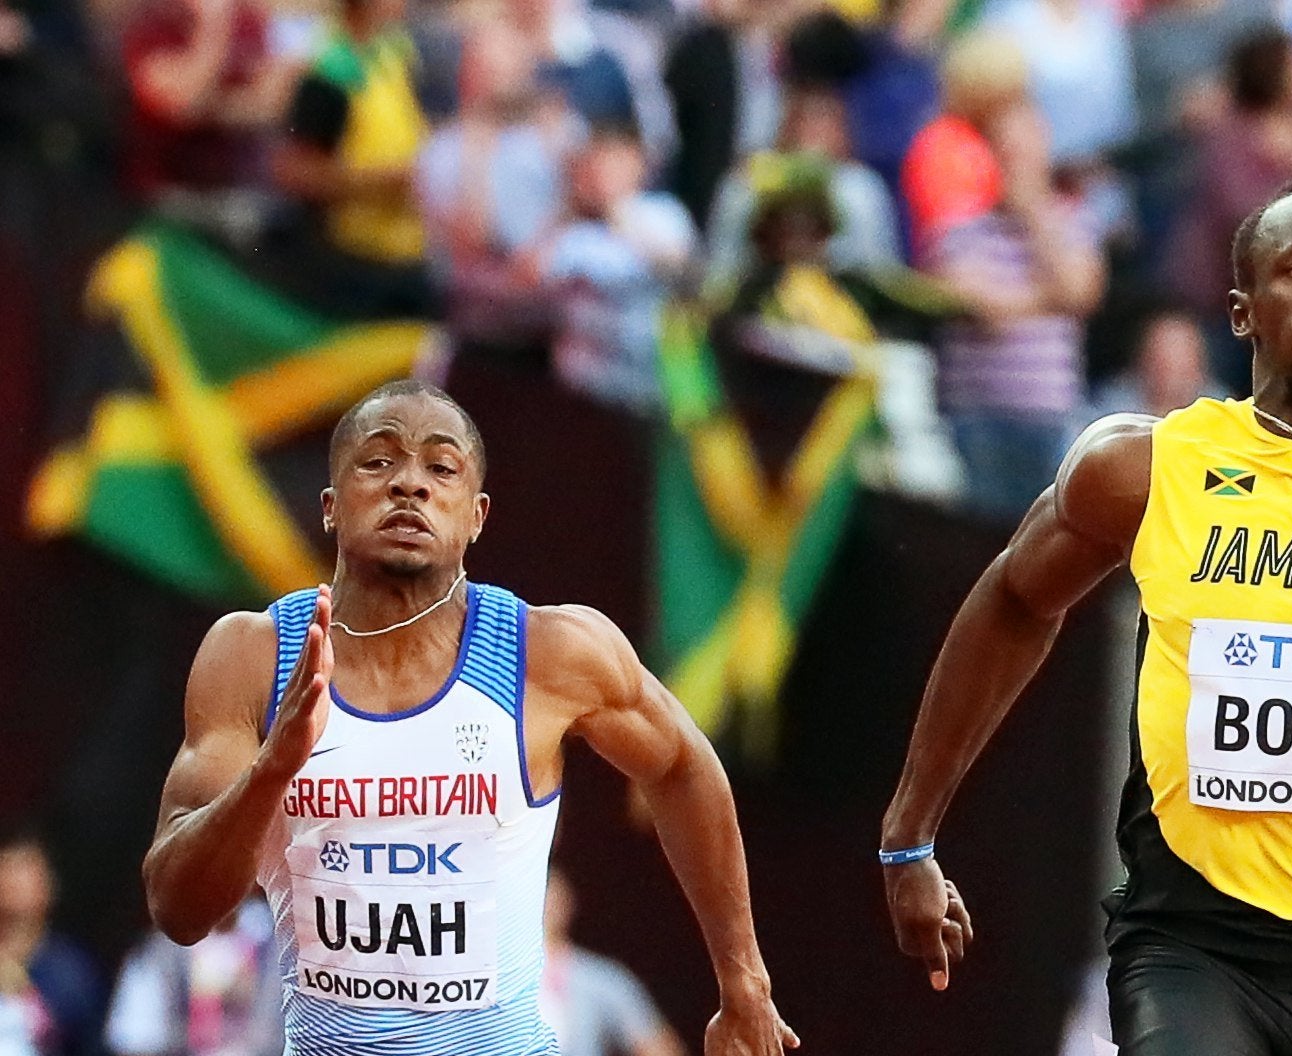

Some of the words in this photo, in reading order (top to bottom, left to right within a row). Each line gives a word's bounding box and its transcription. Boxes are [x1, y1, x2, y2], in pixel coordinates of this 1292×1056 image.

[283, 777, 373, 818] GREAT
[379, 772, 497, 816] BRITAIN
[350, 841, 463, 875] TDK
[314, 895, 466, 957] UJAH
[304, 967, 418, 1003] LONDON
[424, 977, 490, 1005] 2017
